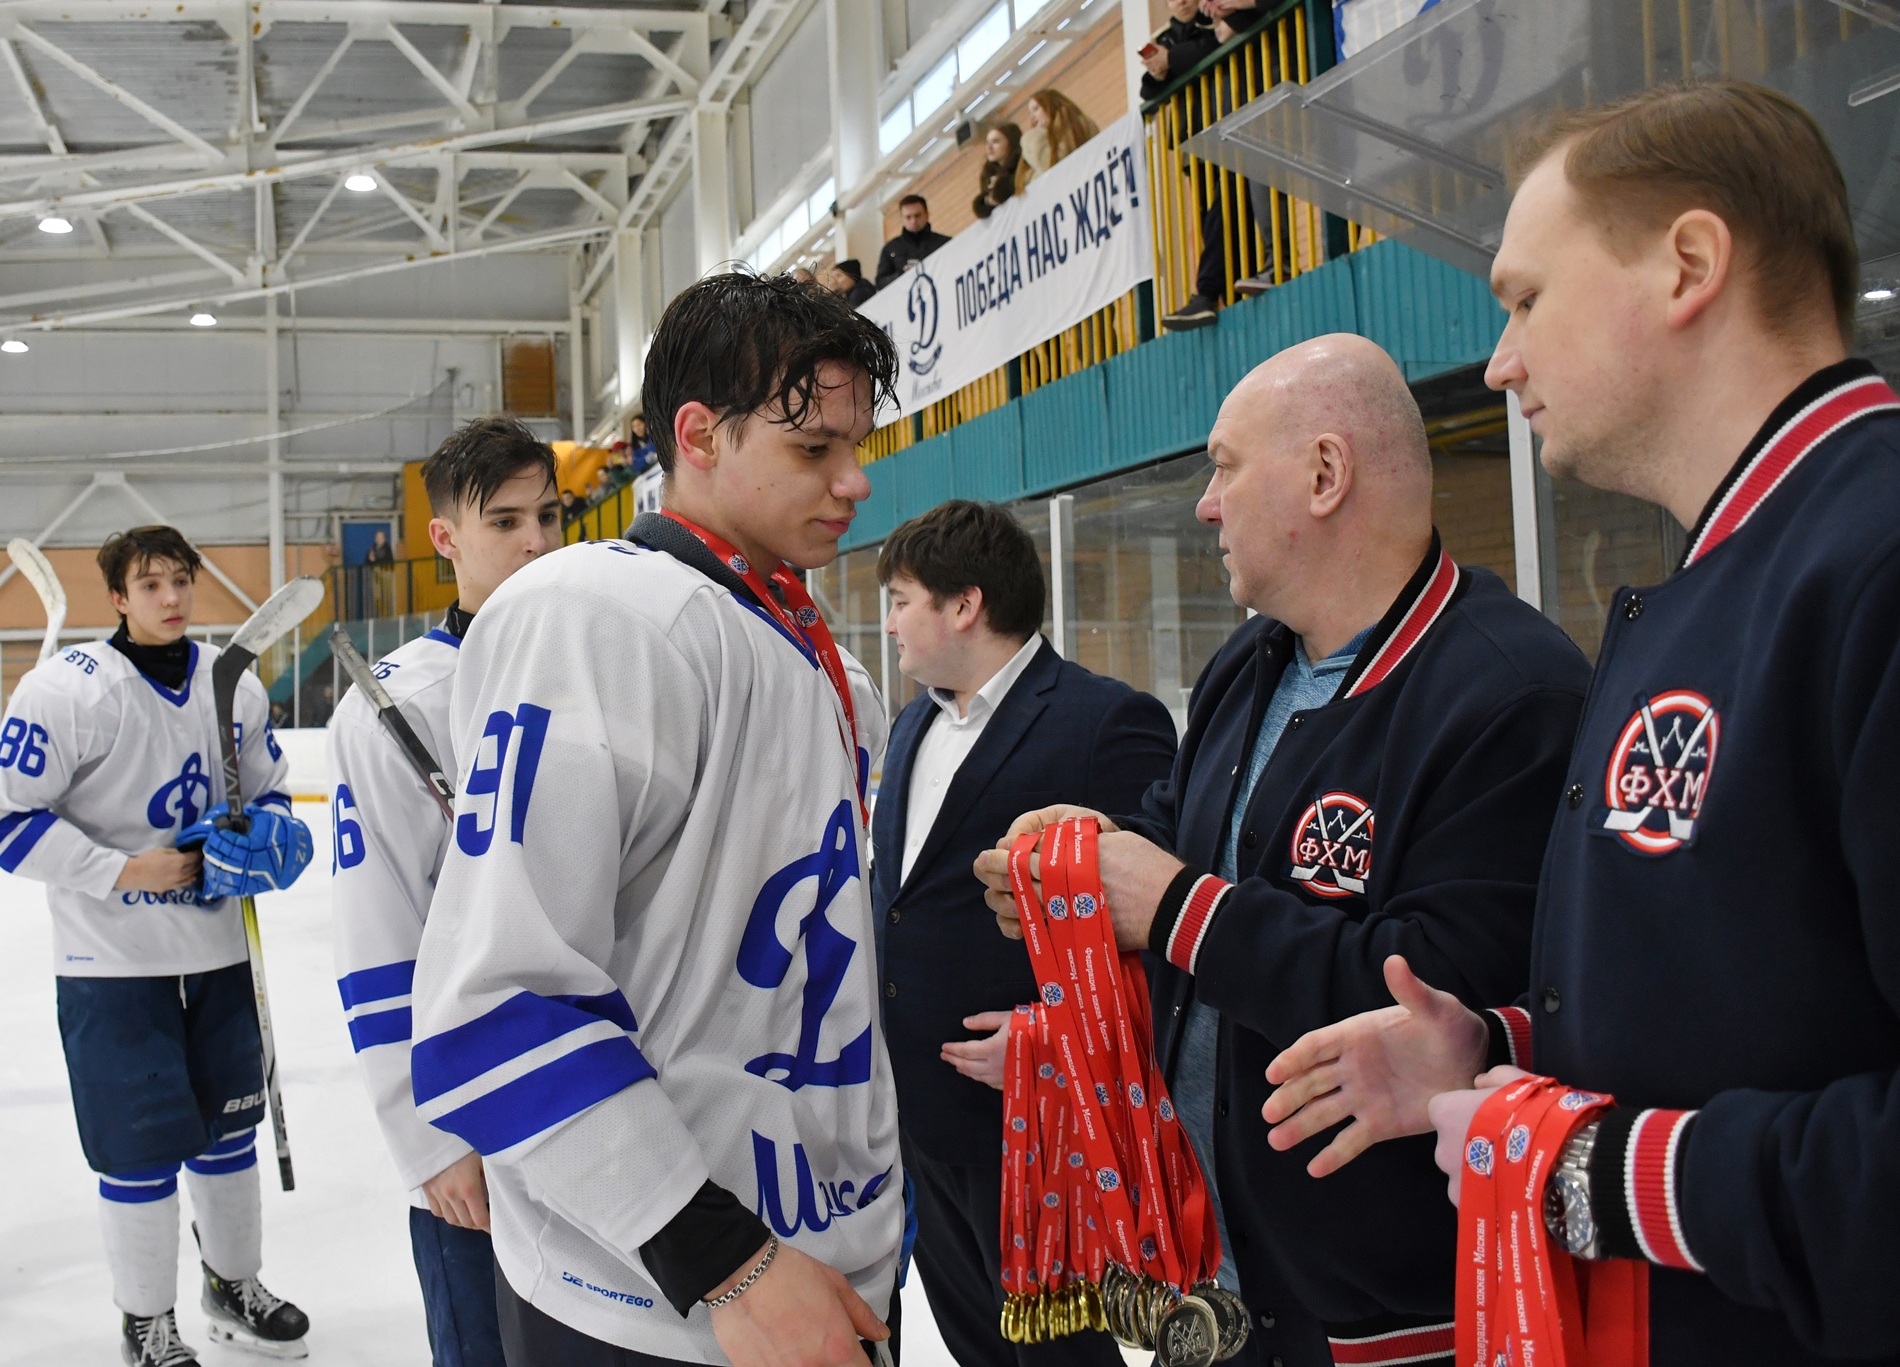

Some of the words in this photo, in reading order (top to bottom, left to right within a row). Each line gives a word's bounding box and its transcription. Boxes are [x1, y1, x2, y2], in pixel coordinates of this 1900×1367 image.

[955, 235, 1022, 331] ПОБЕДА
[1025, 203, 1068, 283] НАС
[64, 650, 99, 675] ВТБ
[821, 649, 840, 688] Федерация
[0, 716, 49, 778] 86
[456, 702, 551, 857] 91
[1619, 765, 1706, 810] ФХМ
[1075, 834, 1083, 864] Москвы
[1299, 837, 1368, 873] ФХМ
[1020, 894, 1032, 920] хоккея
[1028, 922, 1042, 955] Москвы
[1067, 948, 1078, 980] Москвы
[1074, 983, 1084, 1009] хоккея
[1085, 947, 1097, 991] Федерация
[1091, 993, 1102, 1020] хоккея
[1098, 1020, 1111, 1051] Москвы
[1119, 1020, 1128, 1052] Москвы
[1060, 1034, 1077, 1077] Федерация
[1073, 1080, 1085, 1106] хоккея
[1082, 1108, 1096, 1140] Москвы
[1142, 1138, 1154, 1184] Федерация
[1151, 1187, 1160, 1215] хоккея
[1157, 1218, 1167, 1252] Москвы
[1524, 1149, 1545, 1200] Москвы
[1116, 1219, 1132, 1263] Федерация
[1473, 1218, 1486, 1264] Москвы
[1510, 1211, 1522, 1283] Федерация
[1526, 1206, 1538, 1250] хоккея
[586, 1283, 654, 1308] SPORTEGO
[1476, 1268, 1486, 1306] хоккея
[1515, 1288, 1529, 1333] хоккея
